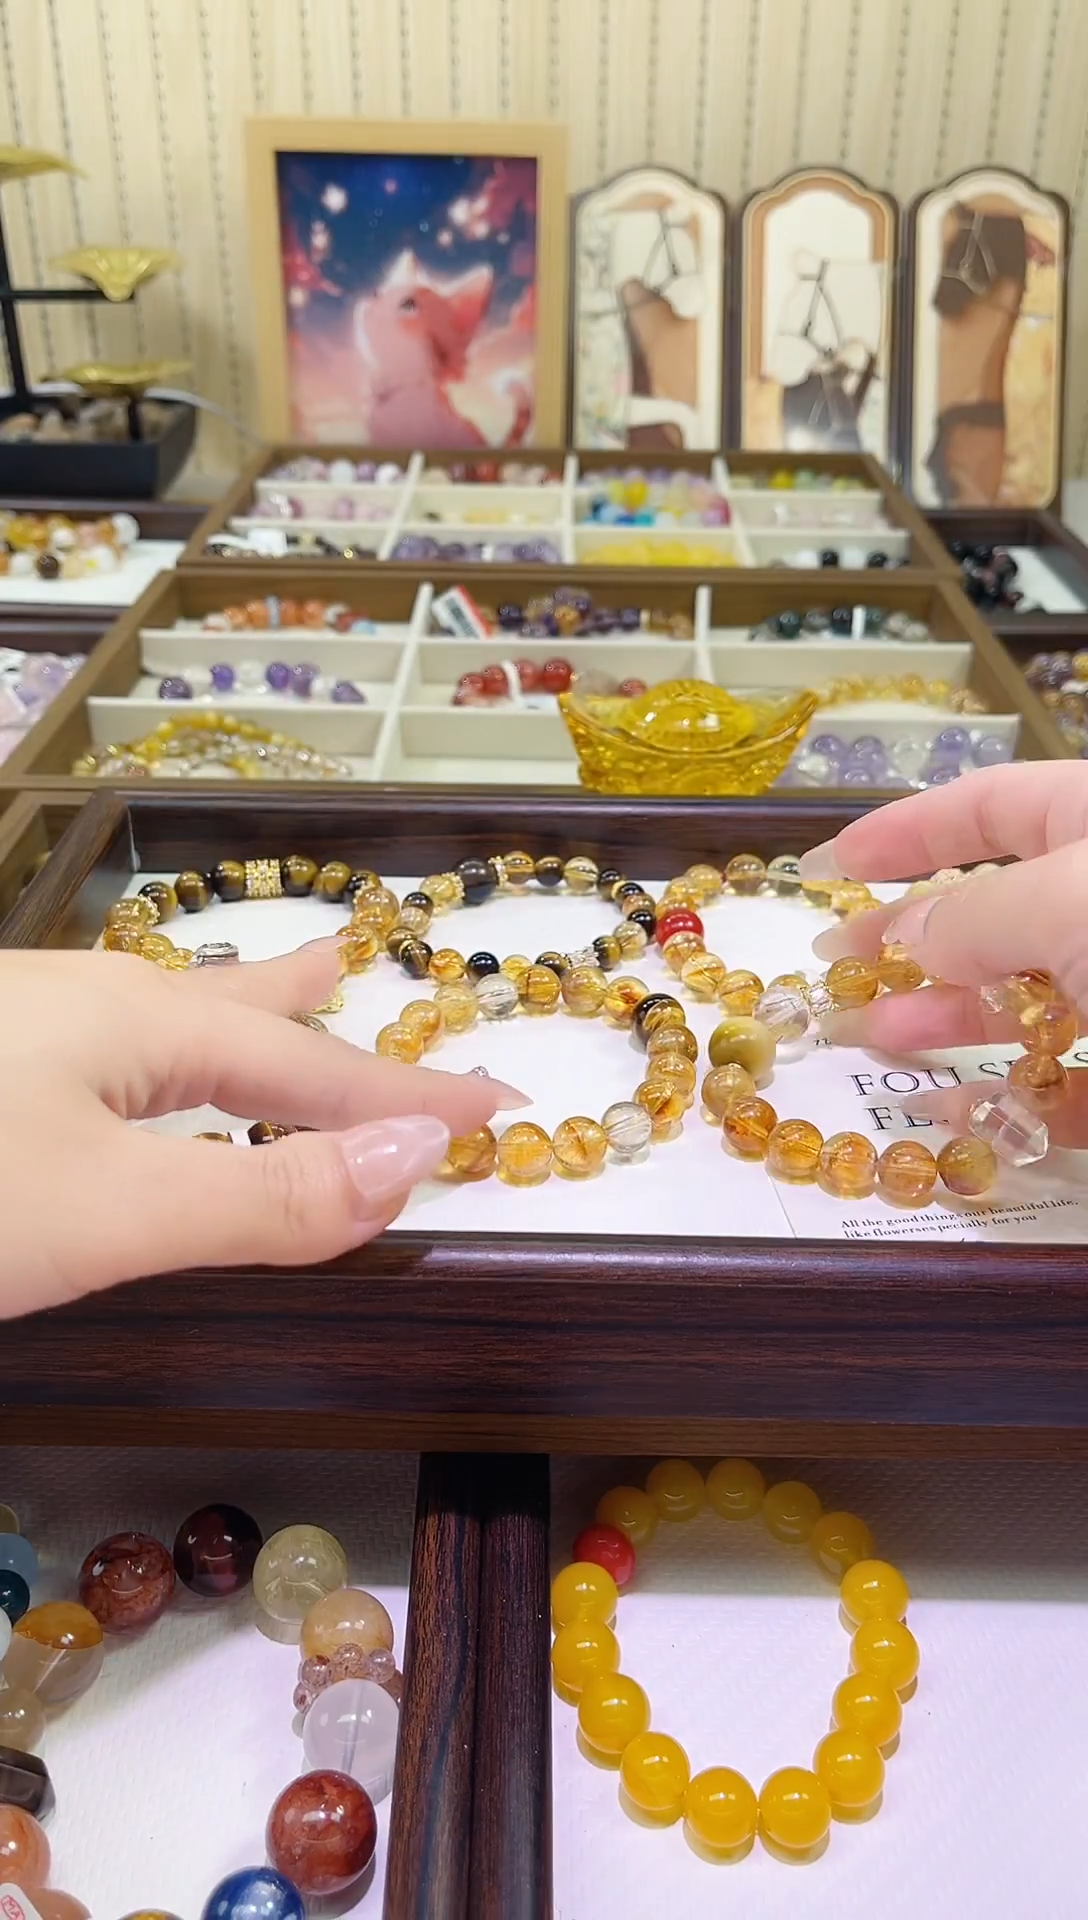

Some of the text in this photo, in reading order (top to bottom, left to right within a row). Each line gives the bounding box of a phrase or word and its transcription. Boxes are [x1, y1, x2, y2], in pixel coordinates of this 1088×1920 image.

[841, 1219, 860, 1228] All
[862, 1218, 883, 1227] the
[844, 1229, 872, 1239] like
[991, 1216, 1011, 1225] for
[1013, 1214, 1037, 1224] you
